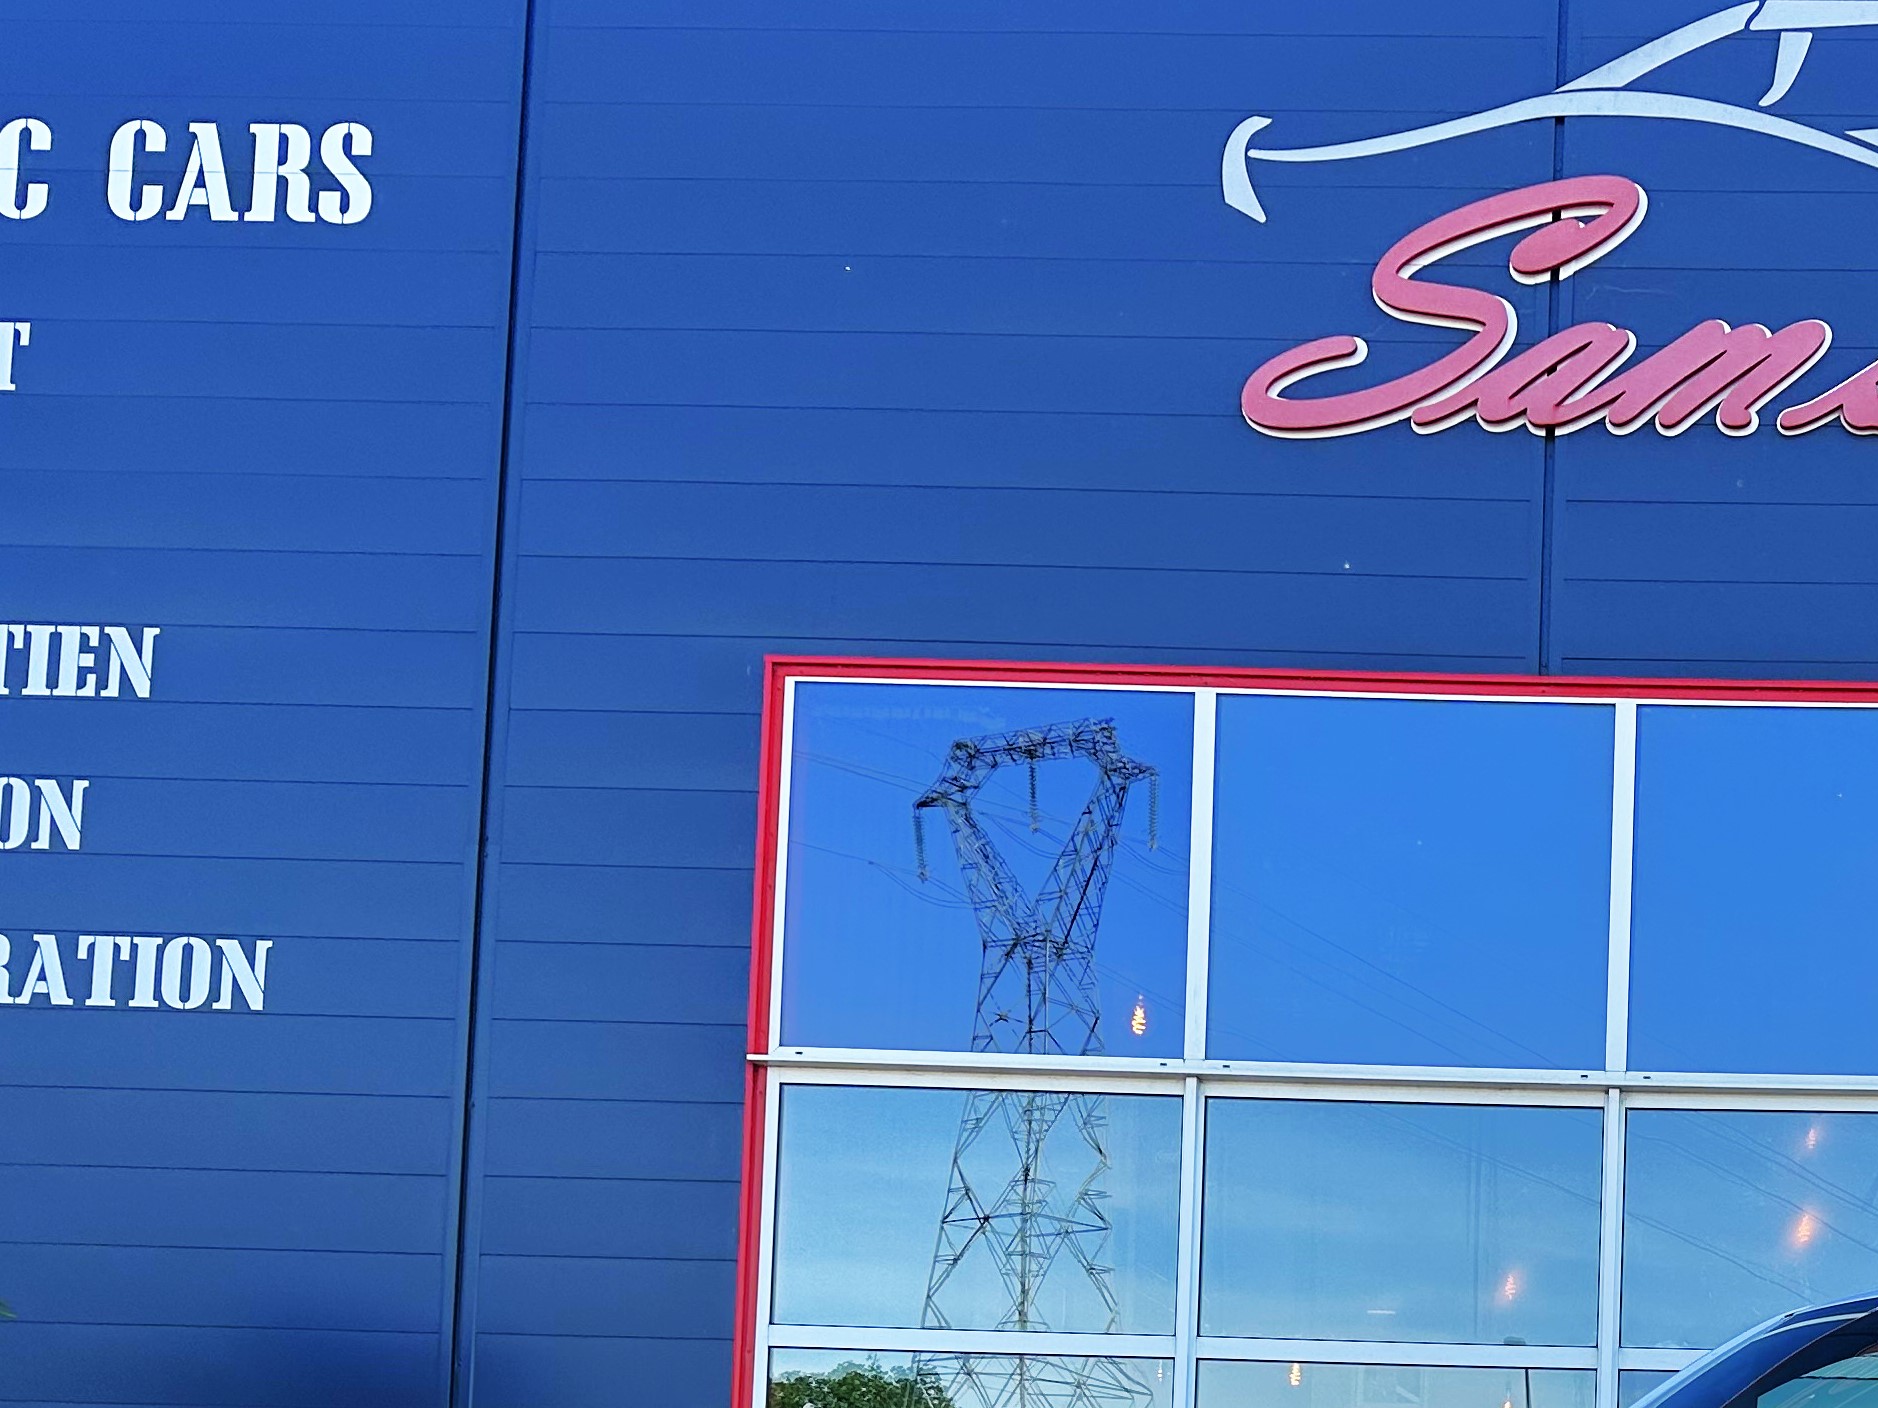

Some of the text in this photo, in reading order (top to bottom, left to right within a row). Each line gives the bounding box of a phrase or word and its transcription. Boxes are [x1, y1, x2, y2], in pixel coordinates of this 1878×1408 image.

[0, 118, 373, 224] C CARS
[0, 777, 90, 850] ON
[0, 934, 273, 1011] ATION
